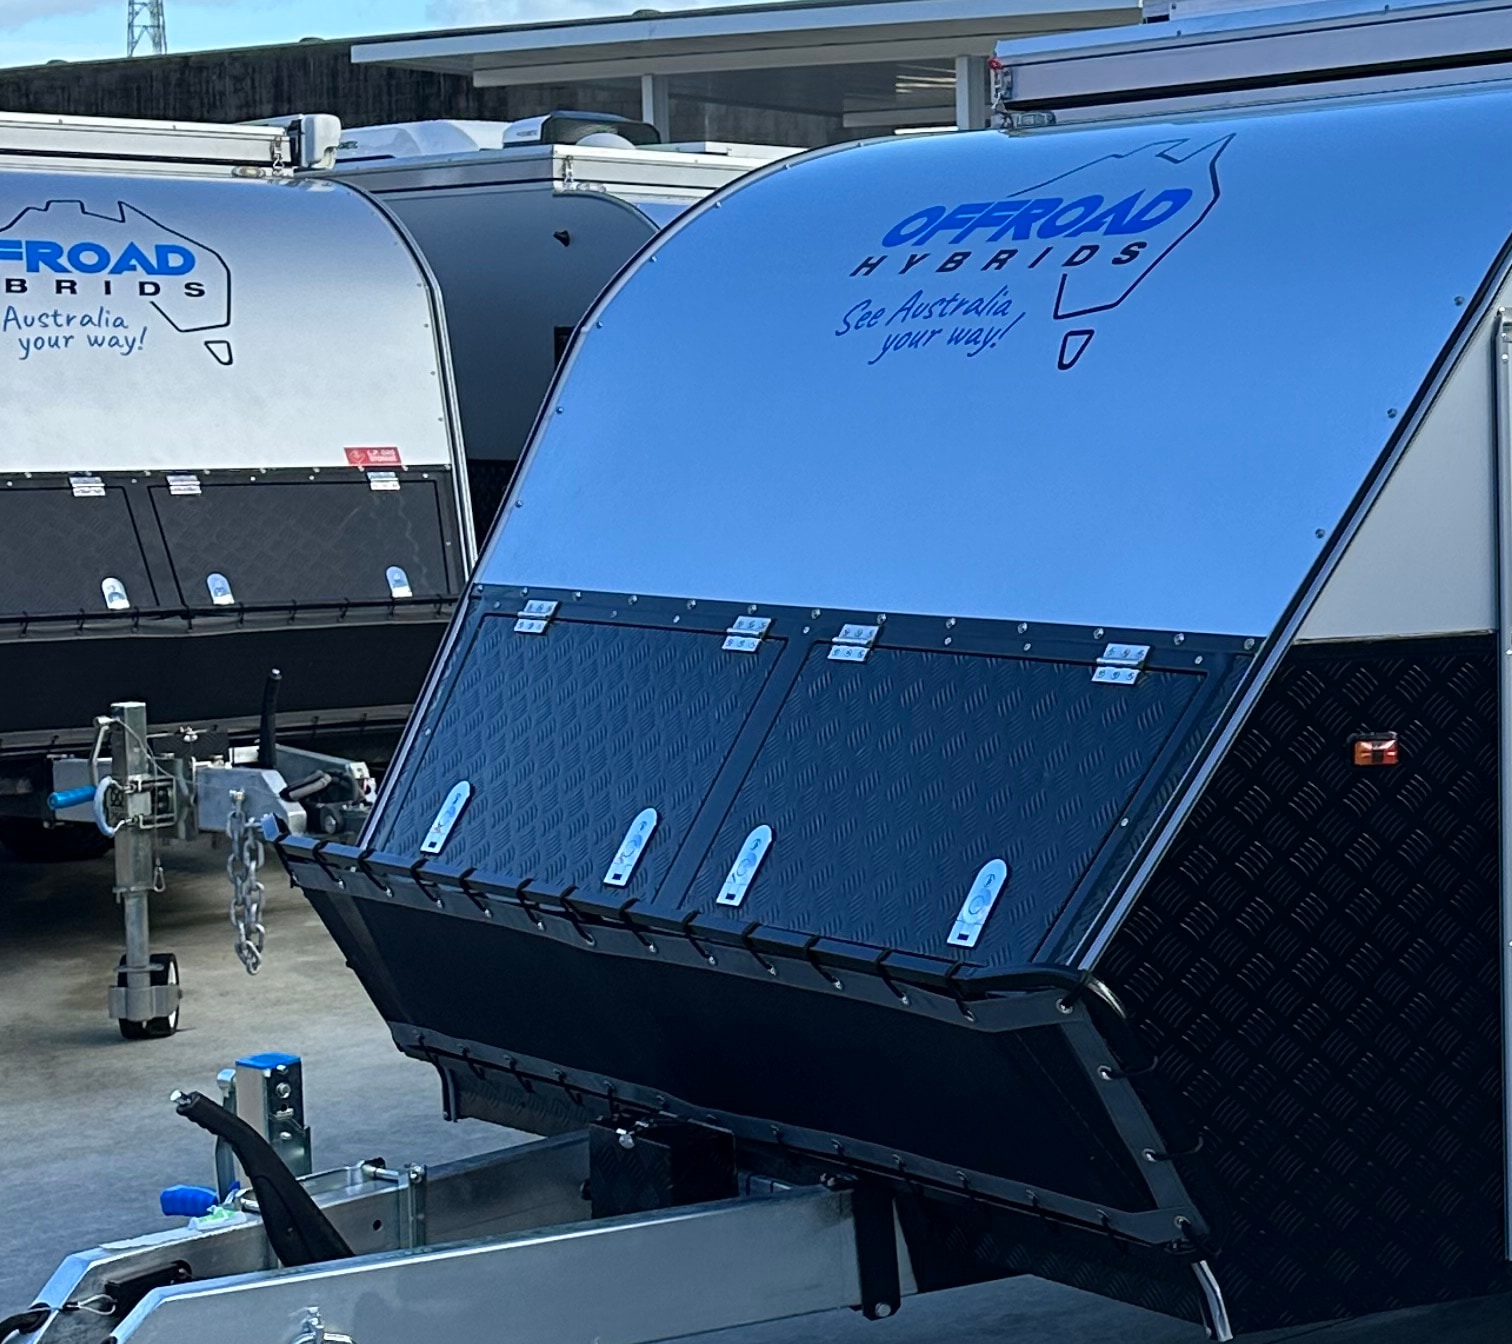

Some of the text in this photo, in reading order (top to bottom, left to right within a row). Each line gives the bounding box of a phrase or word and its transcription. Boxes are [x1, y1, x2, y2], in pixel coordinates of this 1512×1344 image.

[882, 188, 1193, 248] OFFROAD
[849, 241, 1148, 277] HYBRIDS
[5, 278, 206, 298] BRIDS
[3, 305, 129, 332] Australia
[835, 284, 1012, 337] See Australia
[18, 326, 148, 361] your way!
[867, 312, 1026, 365] your way!
